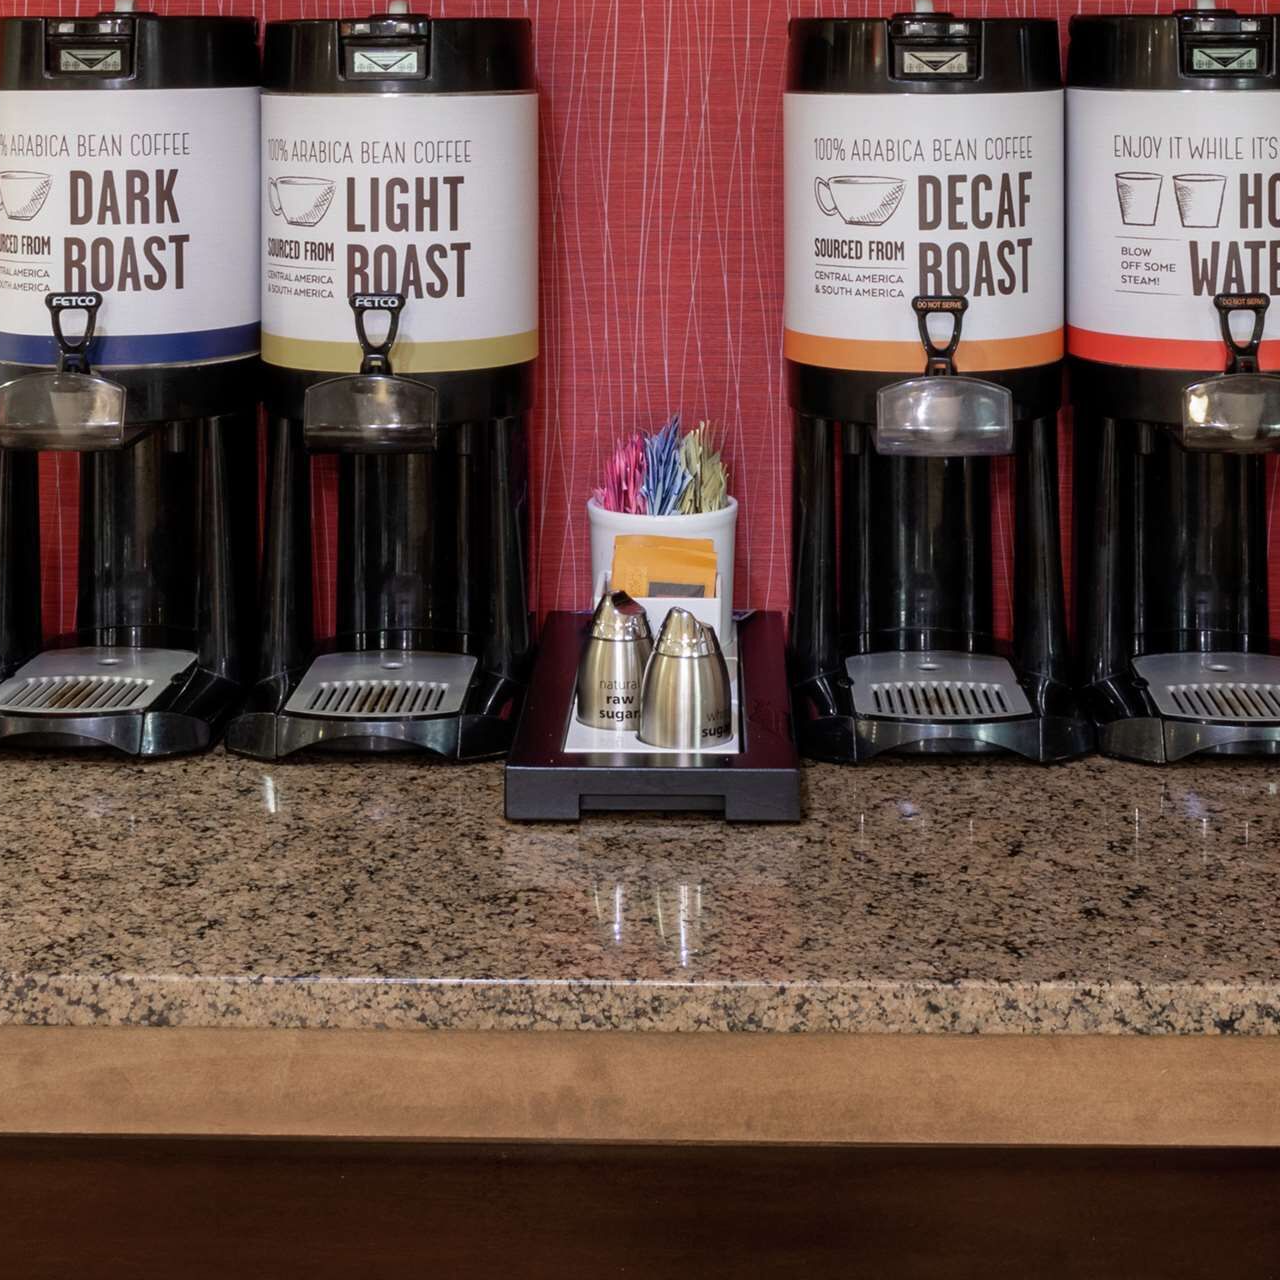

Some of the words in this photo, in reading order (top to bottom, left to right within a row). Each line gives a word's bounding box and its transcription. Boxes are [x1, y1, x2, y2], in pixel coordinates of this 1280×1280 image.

[11, 134, 70, 158] ARABICA
[77, 134, 122, 158] BEAN
[130, 132, 191, 156] COFFEE
[267, 138, 289, 163] 100%
[292, 140, 354, 164] ARABICA
[361, 141, 406, 164] BEAN
[414, 140, 472, 164] COFFEE
[814, 137, 846, 161] 100%
[851, 138, 925, 162] ARABICA
[933, 138, 977, 162] BEAN
[985, 136, 1033, 161] COFFEE
[1113, 135, 1162, 159] ENJOY
[1169, 136, 1183, 159] IT
[1187, 136, 1244, 160] WHILE
[1252, 135, 1278, 159] IT'S
[70, 169, 180, 225] DARK
[347, 176, 465, 233] LIGHT
[918, 171, 1033, 231] DECAF
[21, 236, 51, 256] FROM
[267, 237, 300, 261] SOURCED
[304, 241, 335, 262] FROM
[814, 238, 863, 260] SOURCED
[868, 241, 905, 261] FROM
[1121, 246, 1152, 258] BLOW
[64, 234, 190, 293] ROAST
[347, 242, 472, 299] ROAST
[919, 238, 1033, 297] ROAST
[1121, 260, 1141, 271] OFF
[1144, 262, 1177, 273] SOME
[14, 268, 50, 278] AMERICA
[268, 270, 293, 283] CENTRAL
[294, 273, 333, 285] AMERICA
[814, 271, 853, 282] CENTRAL
[855, 273, 905, 284] AMERICA
[1121, 274, 1160, 286] STEAM!
[13, 282, 51, 293] AMERICA
[272, 285, 293, 296] SOUTH
[293, 288, 334, 299] AMERICA
[822, 285, 853, 296] SOUTH
[854, 287, 905, 298] AMERICA
[52, 296, 96, 307] FETCO
[355, 298, 399, 308] FETCO
[599, 679, 641, 690] natural
[606, 695, 634, 705] raw
[599, 708, 641, 722] sugar
